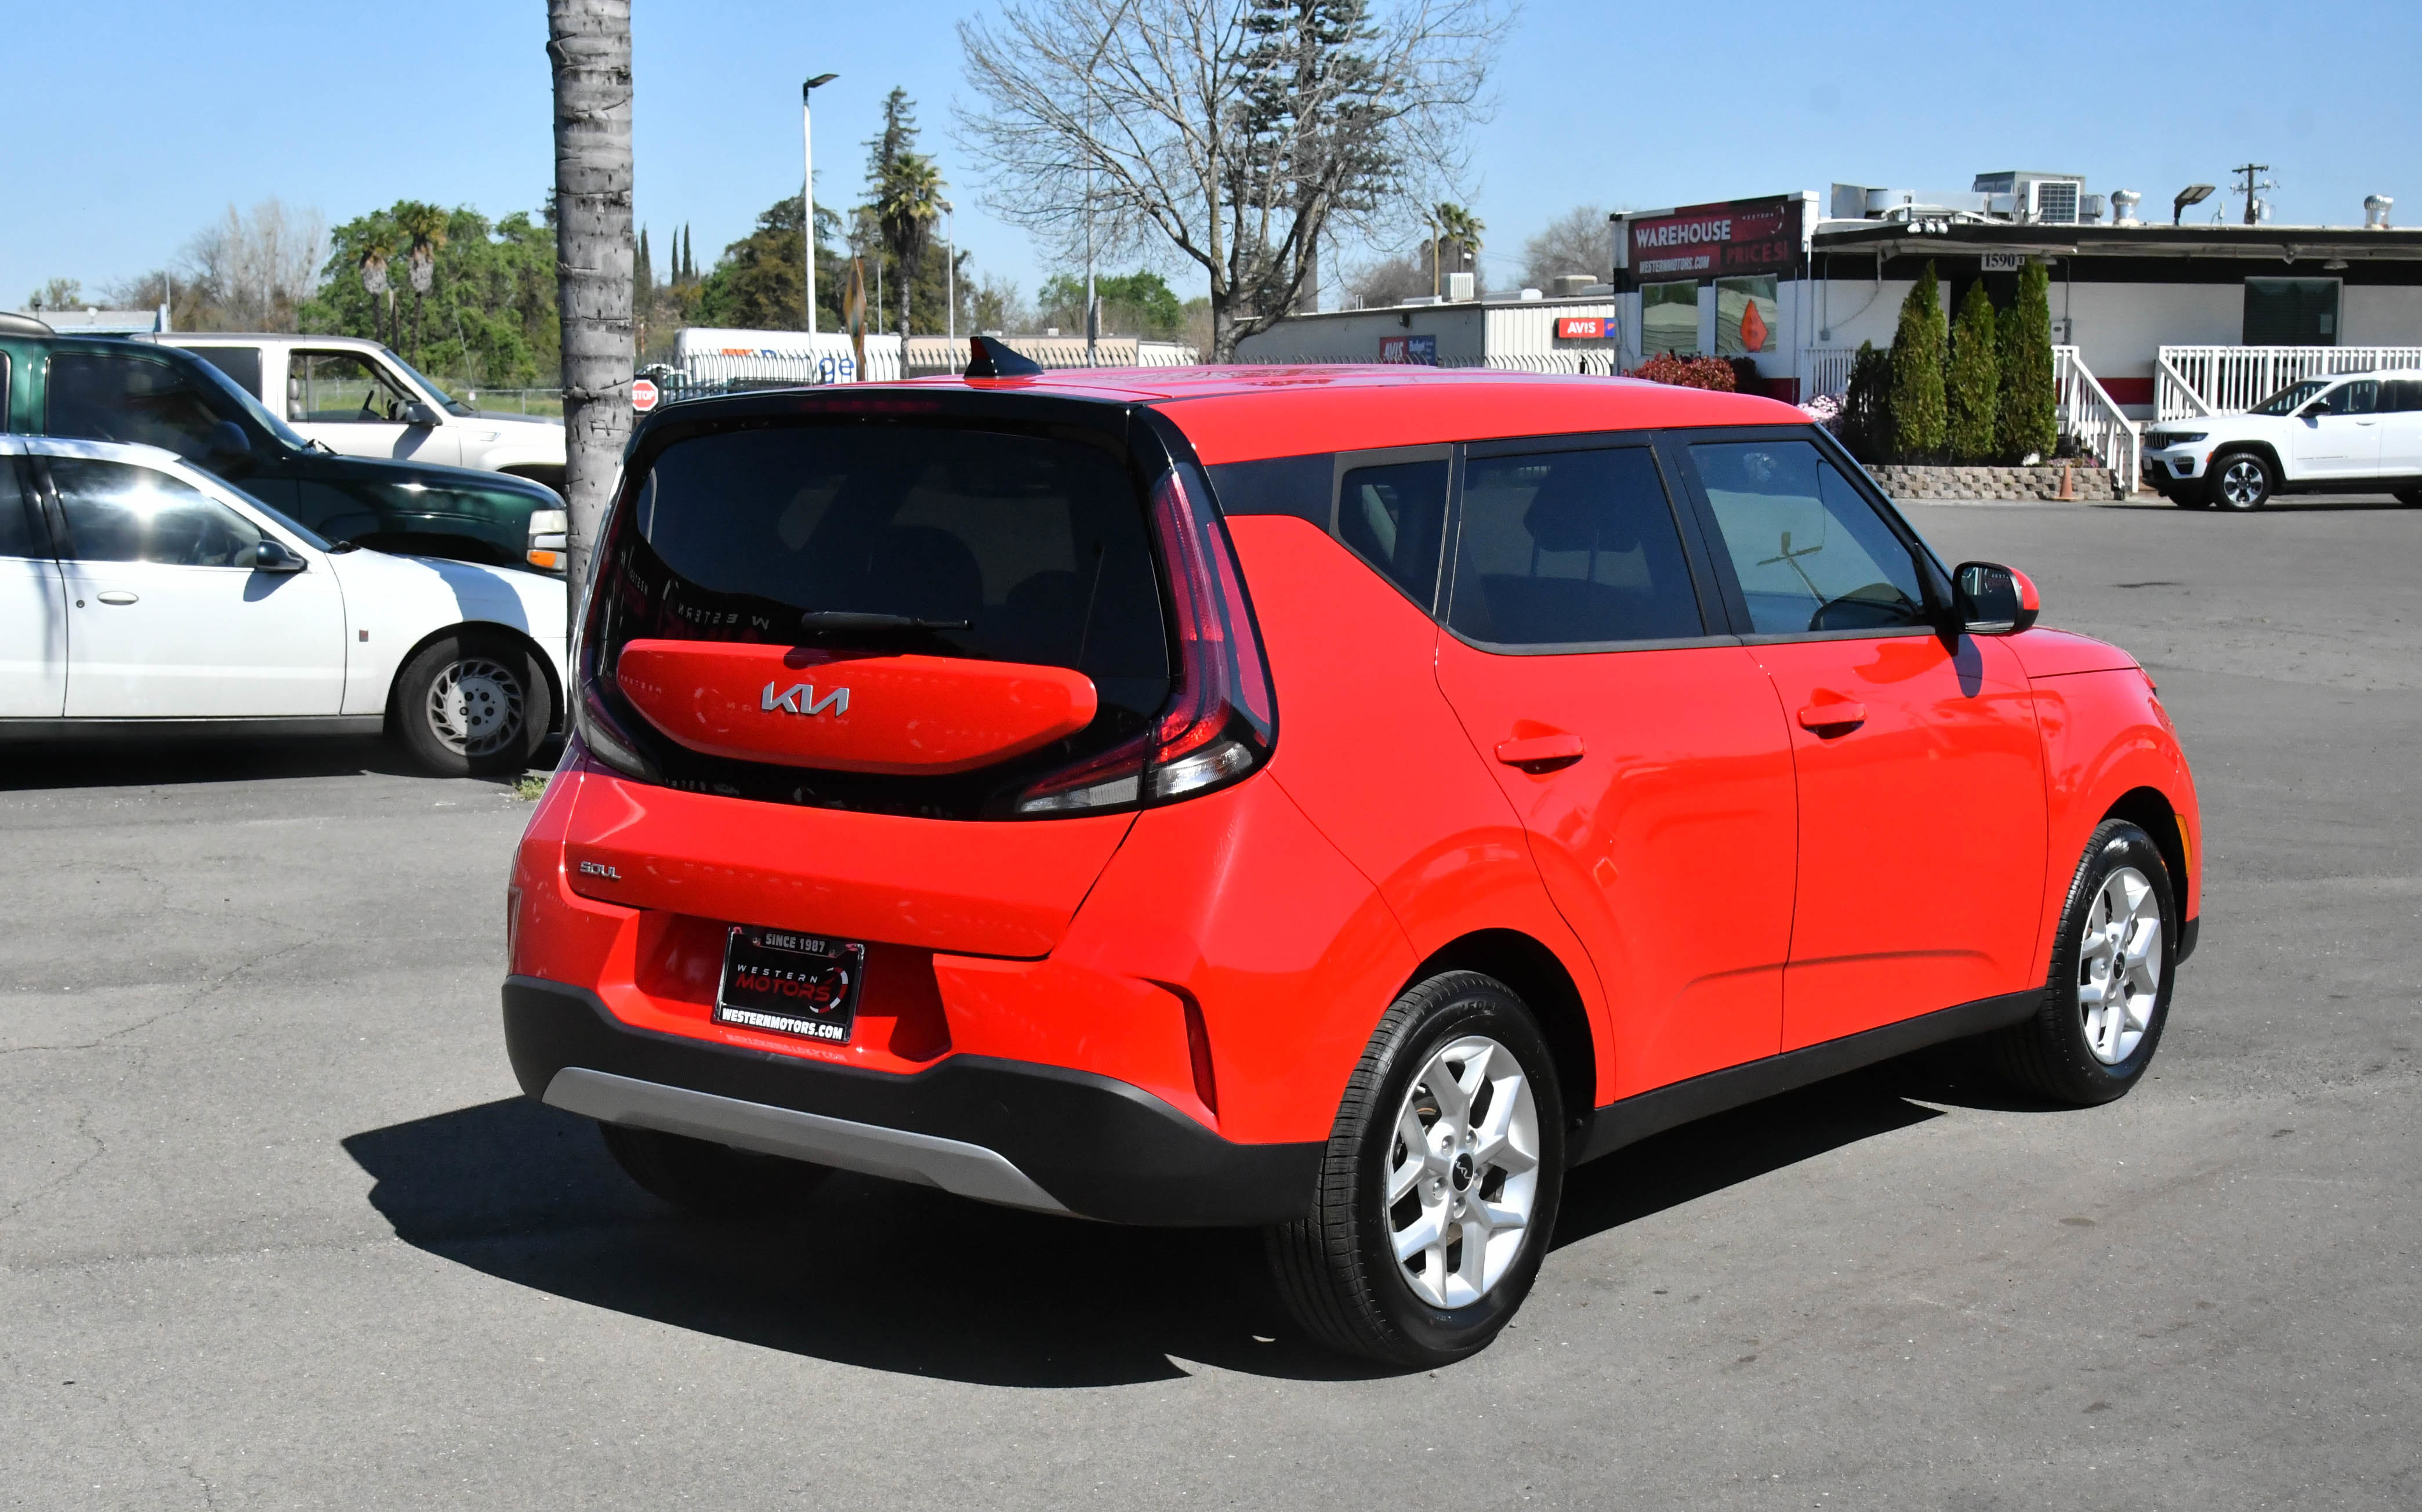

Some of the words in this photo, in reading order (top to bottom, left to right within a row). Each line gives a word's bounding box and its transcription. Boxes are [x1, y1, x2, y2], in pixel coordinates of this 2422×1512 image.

[1636, 219, 1731, 248] WAREHOUSE
[1727, 240, 1789, 264] PRICES!
[1985, 253, 2015, 267] 1590
[1567, 322, 1596, 333] AVIS
[1384, 340, 1404, 361] AVIS
[632, 390, 655, 400] STOP
[761, 681, 850, 717] KIA
[579, 861, 622, 879] SOUL
[766, 933, 796, 948] SINCE
[800, 938, 825, 952] 1987
[737, 964, 818, 984] WESTERN
[735, 972, 831, 1002] MOTORS
[722, 1008, 843, 1040] WESTERNMOTORS.COM
